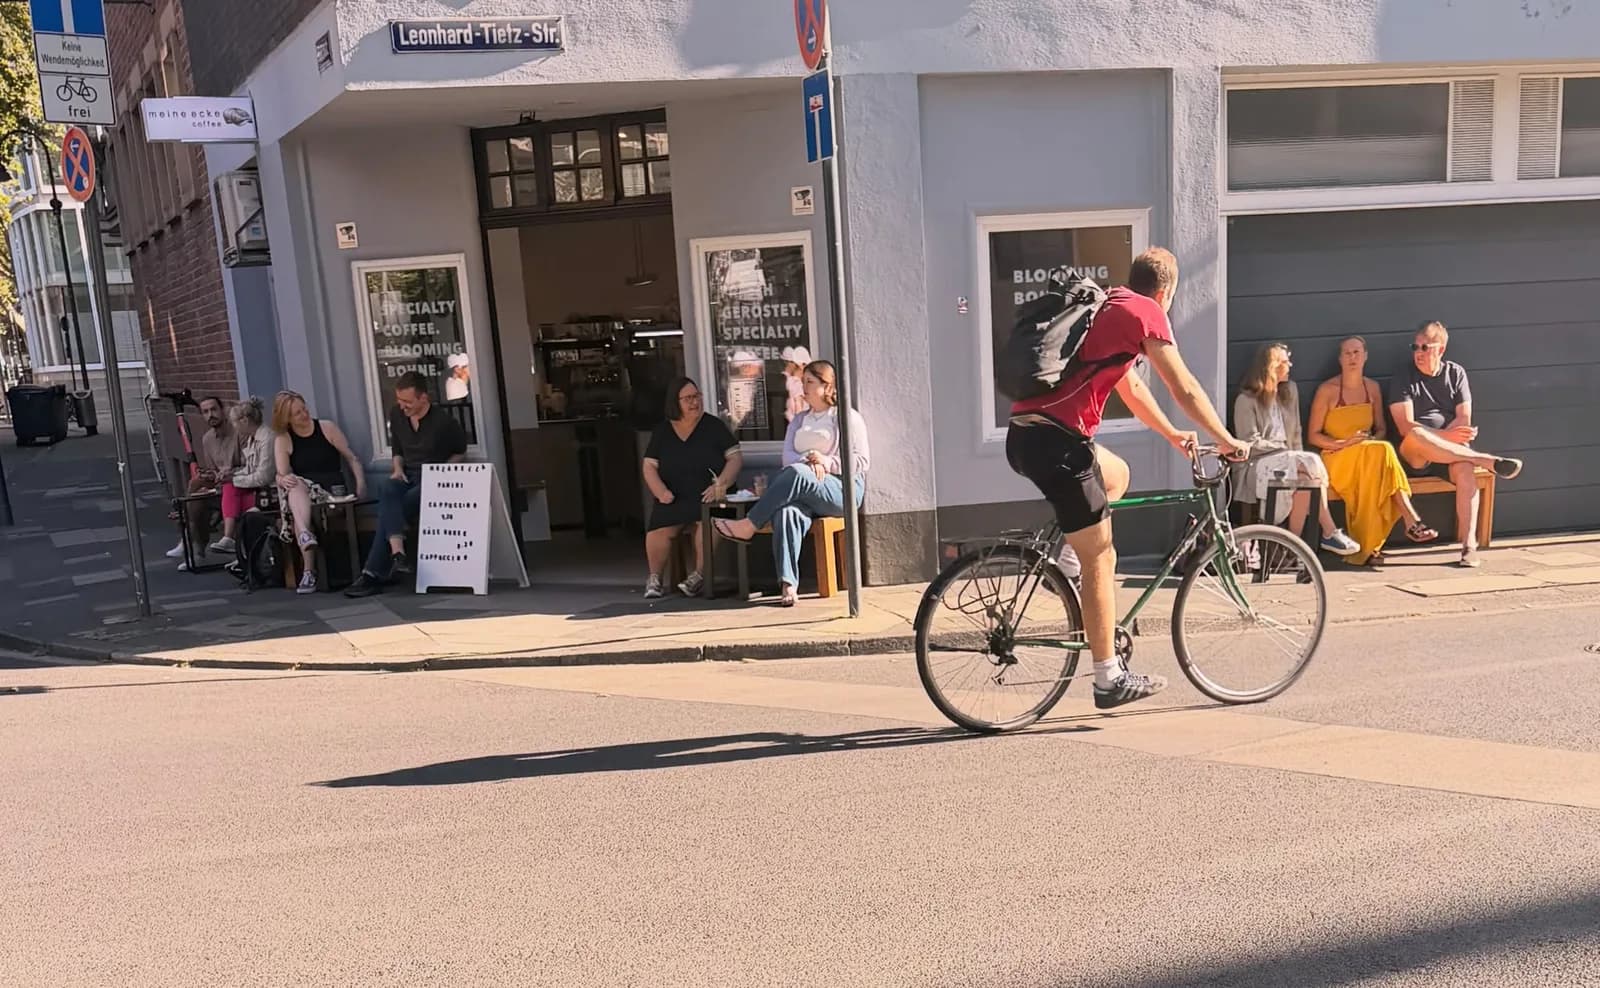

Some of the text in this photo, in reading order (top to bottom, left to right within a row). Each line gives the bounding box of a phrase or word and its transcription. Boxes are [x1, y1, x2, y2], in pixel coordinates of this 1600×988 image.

[399, 22, 560, 46] Leonhard-Tietz-Str.
[61, 40, 82, 52] Keine
[40, 53, 105, 68] Wendemöglichkeit
[68, 105, 91, 118] frei
[148, 109, 221, 118] meine ecke
[1013, 265, 1109, 284] BLOING
[382, 300, 455, 316] SPECIALTY
[383, 322, 440, 337] COFFEE.
[723, 324, 802, 341] SPECIALTY
[384, 342, 463, 357] BLOOMING
[428, 501, 477, 509] CAPPUCCINO
